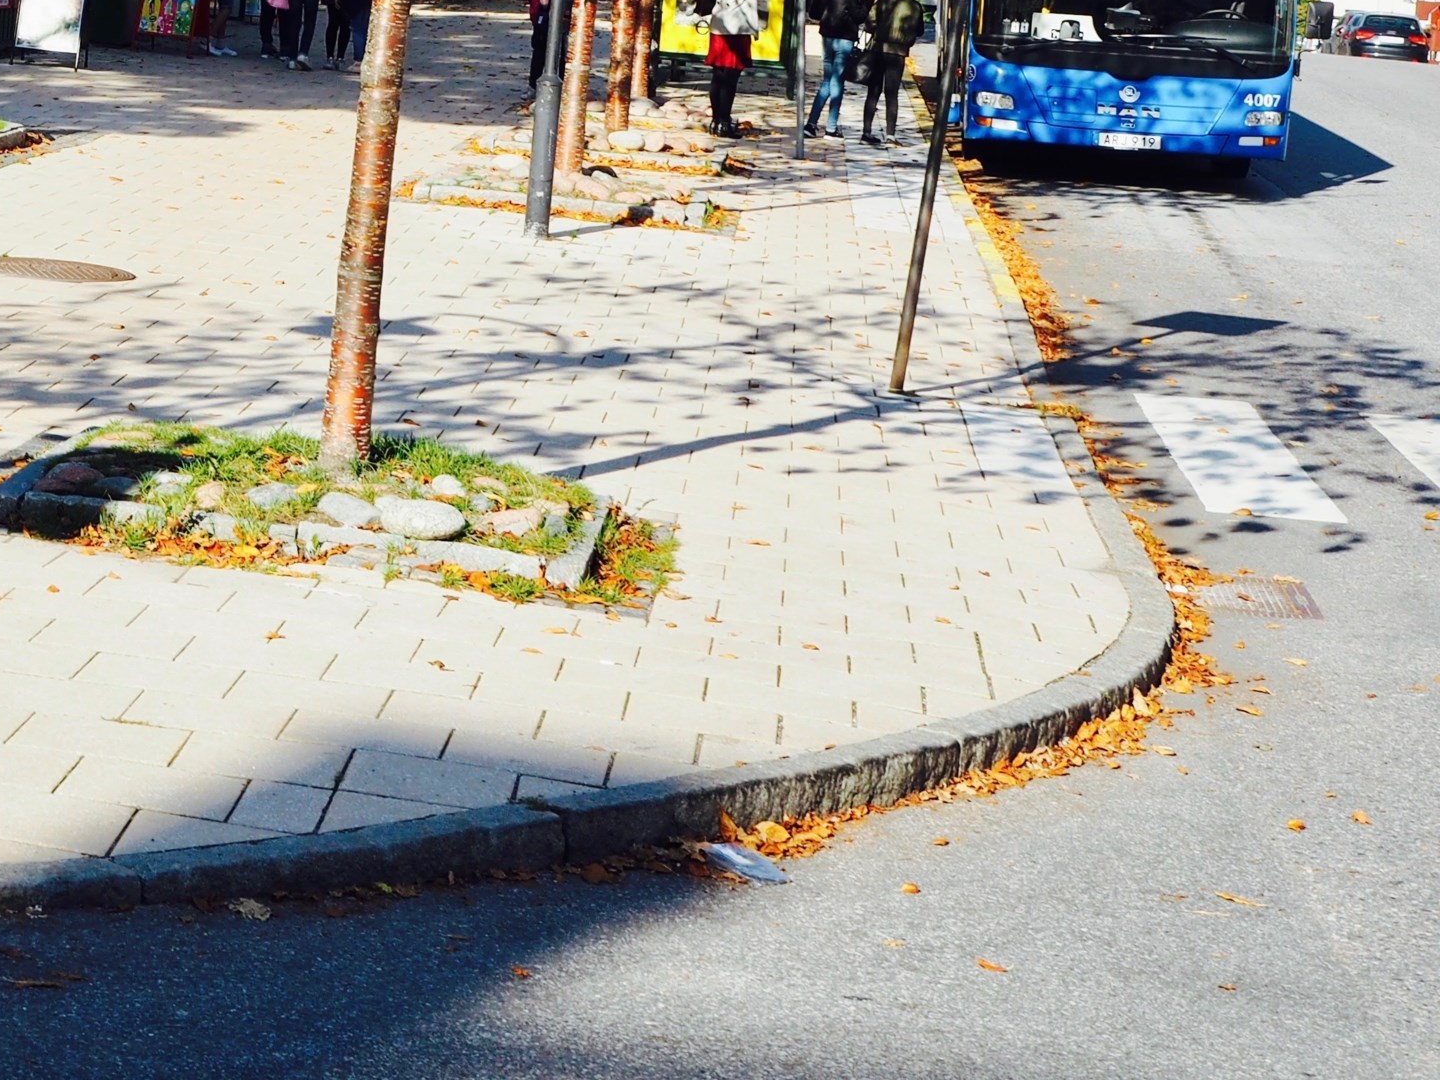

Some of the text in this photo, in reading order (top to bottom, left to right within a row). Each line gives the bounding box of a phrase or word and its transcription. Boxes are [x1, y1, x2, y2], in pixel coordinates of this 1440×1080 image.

[1243, 93, 1281, 108] 4007
[1097, 104, 1161, 119] MAN
[1131, 136, 1156, 148] 919
